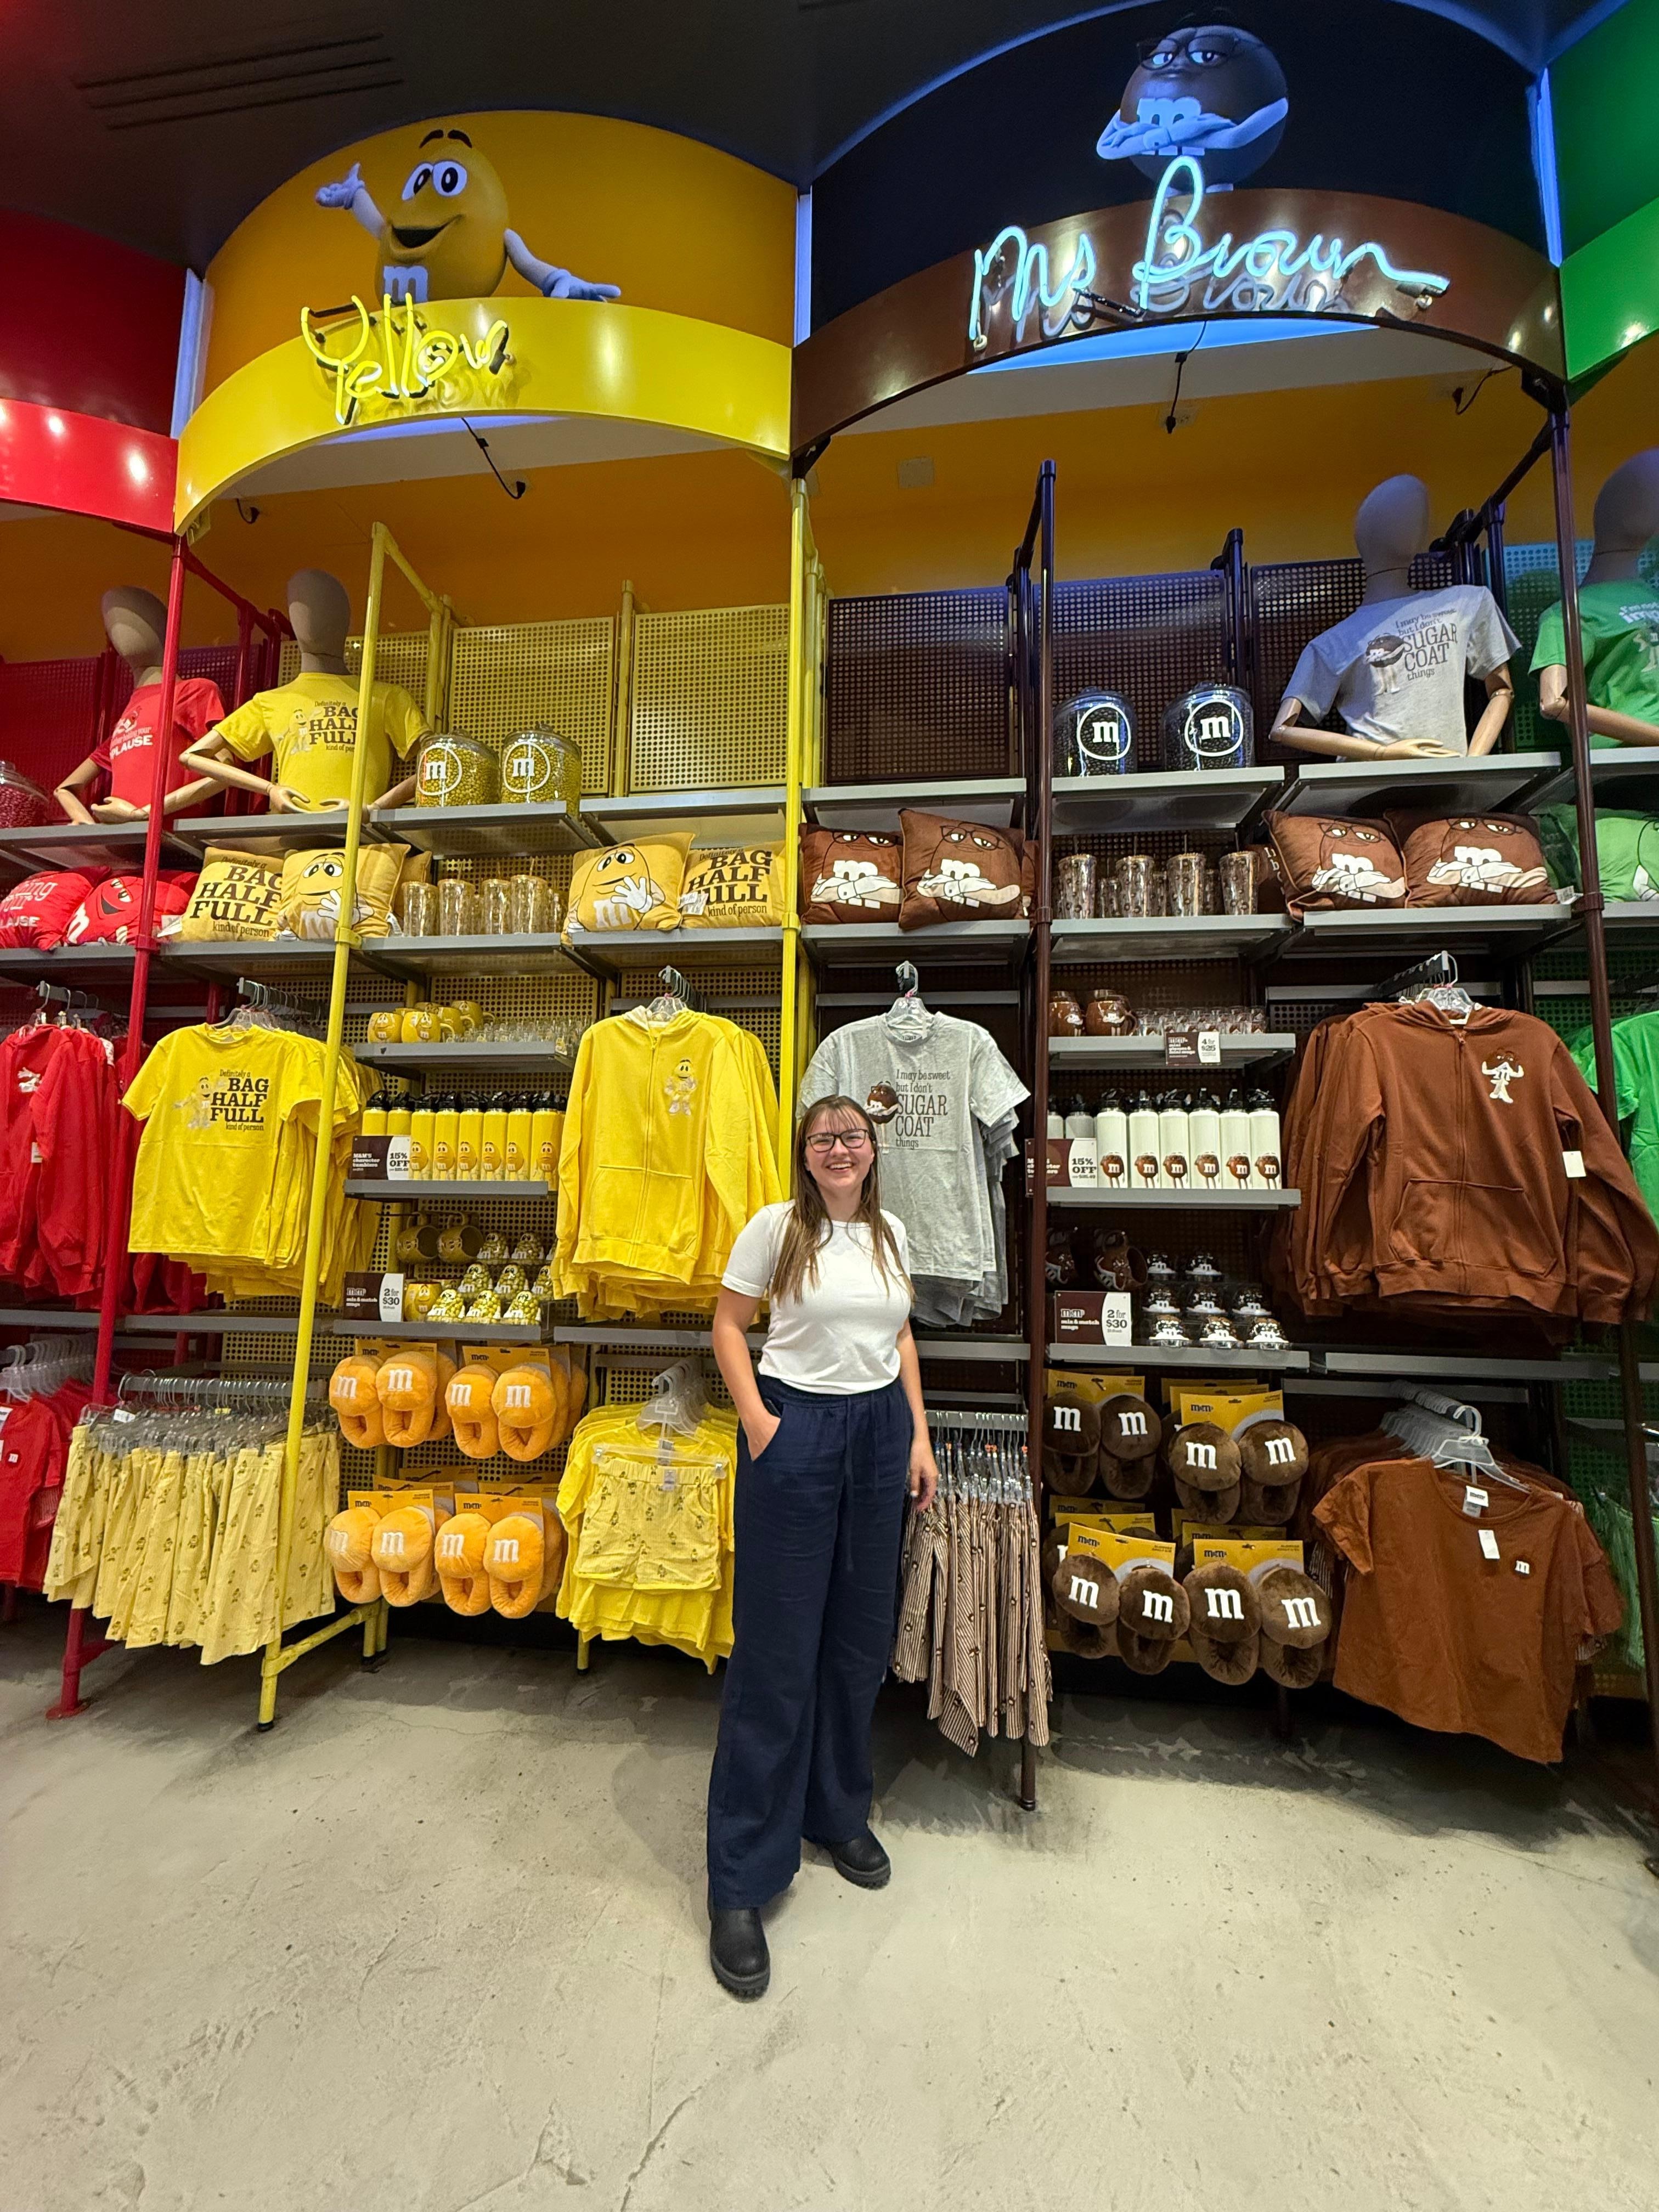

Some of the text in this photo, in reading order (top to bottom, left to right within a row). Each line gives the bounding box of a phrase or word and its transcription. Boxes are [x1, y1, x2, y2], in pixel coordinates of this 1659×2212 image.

[969, 155, 1450, 341] Ms Brown
[301, 292, 508, 425] Yellow
[1398, 628, 1414, 636] but
[1400, 616, 1420, 628] may
[1402, 623, 1458, 653] SUGAR
[1404, 643, 1449, 672] COAT
[1407, 668, 1435, 681] things
[1092, 721, 1119, 743] m
[1200, 716, 1231, 740] m
[110, 735, 153, 760] PLAUSE
[426, 761, 447, 780] m
[512, 758, 535, 777] m
[221, 856, 259, 868] Definitely
[707, 850, 772, 871] BAG
[687, 866, 770, 893] HALF
[196, 882, 282, 909] HALF
[694, 884, 768, 905] ULL
[189, 900, 273, 927] FULL
[708, 904, 767, 917] kind of person
[0, 915, 41, 929] LAUSE
[213, 921, 270, 938] kind of person
[220, 1069, 246, 1079] Definitely
[896, 1069, 951, 1082] I may be sweet
[227, 1078, 269, 1092] BAG
[896, 1082, 933, 1093] but I don't
[211, 1092, 267, 1107] HALF
[896, 1094, 948, 1115] SUGAR
[210, 1108, 264, 1122] FULL
[895, 1116, 934, 1137] COAT
[896, 1137, 919, 1150] things
[1108, 1164, 1120, 1173] m
[1143, 1164, 1155, 1173] m
[1171, 1164, 1183, 1173] m
[1204, 1163, 1216, 1173] m
[1236, 1165, 1248, 1175] m
[1265, 1164, 1277, 1174] m
[383, 1297, 400, 1305] $30
[1106, 1319, 1127, 1328] $30
[1107, 1310, 1115, 1318] 2
[1116, 1310, 1126, 1318] for
[334, 1375, 357, 1400] m
[388, 1369, 413, 1392] m
[450, 1384, 472, 1407] m
[505, 1385, 531, 1407] m
[1053, 1406, 1081, 1432] m
[1118, 1412, 1148, 1436] m
[1186, 1442, 1217, 1470] m
[1265, 1437, 1296, 1465] m
[380, 1531, 405, 1556] m
[442, 1534, 464, 1556] m
[493, 1539, 519, 1563] m
[1515, 1560, 1530, 1575] m
[1069, 1576, 1099, 1609] m
[1142, 1590, 1173, 1623] m
[1205, 1588, 1244, 1620] m
[1281, 1598, 1321, 1629] m
